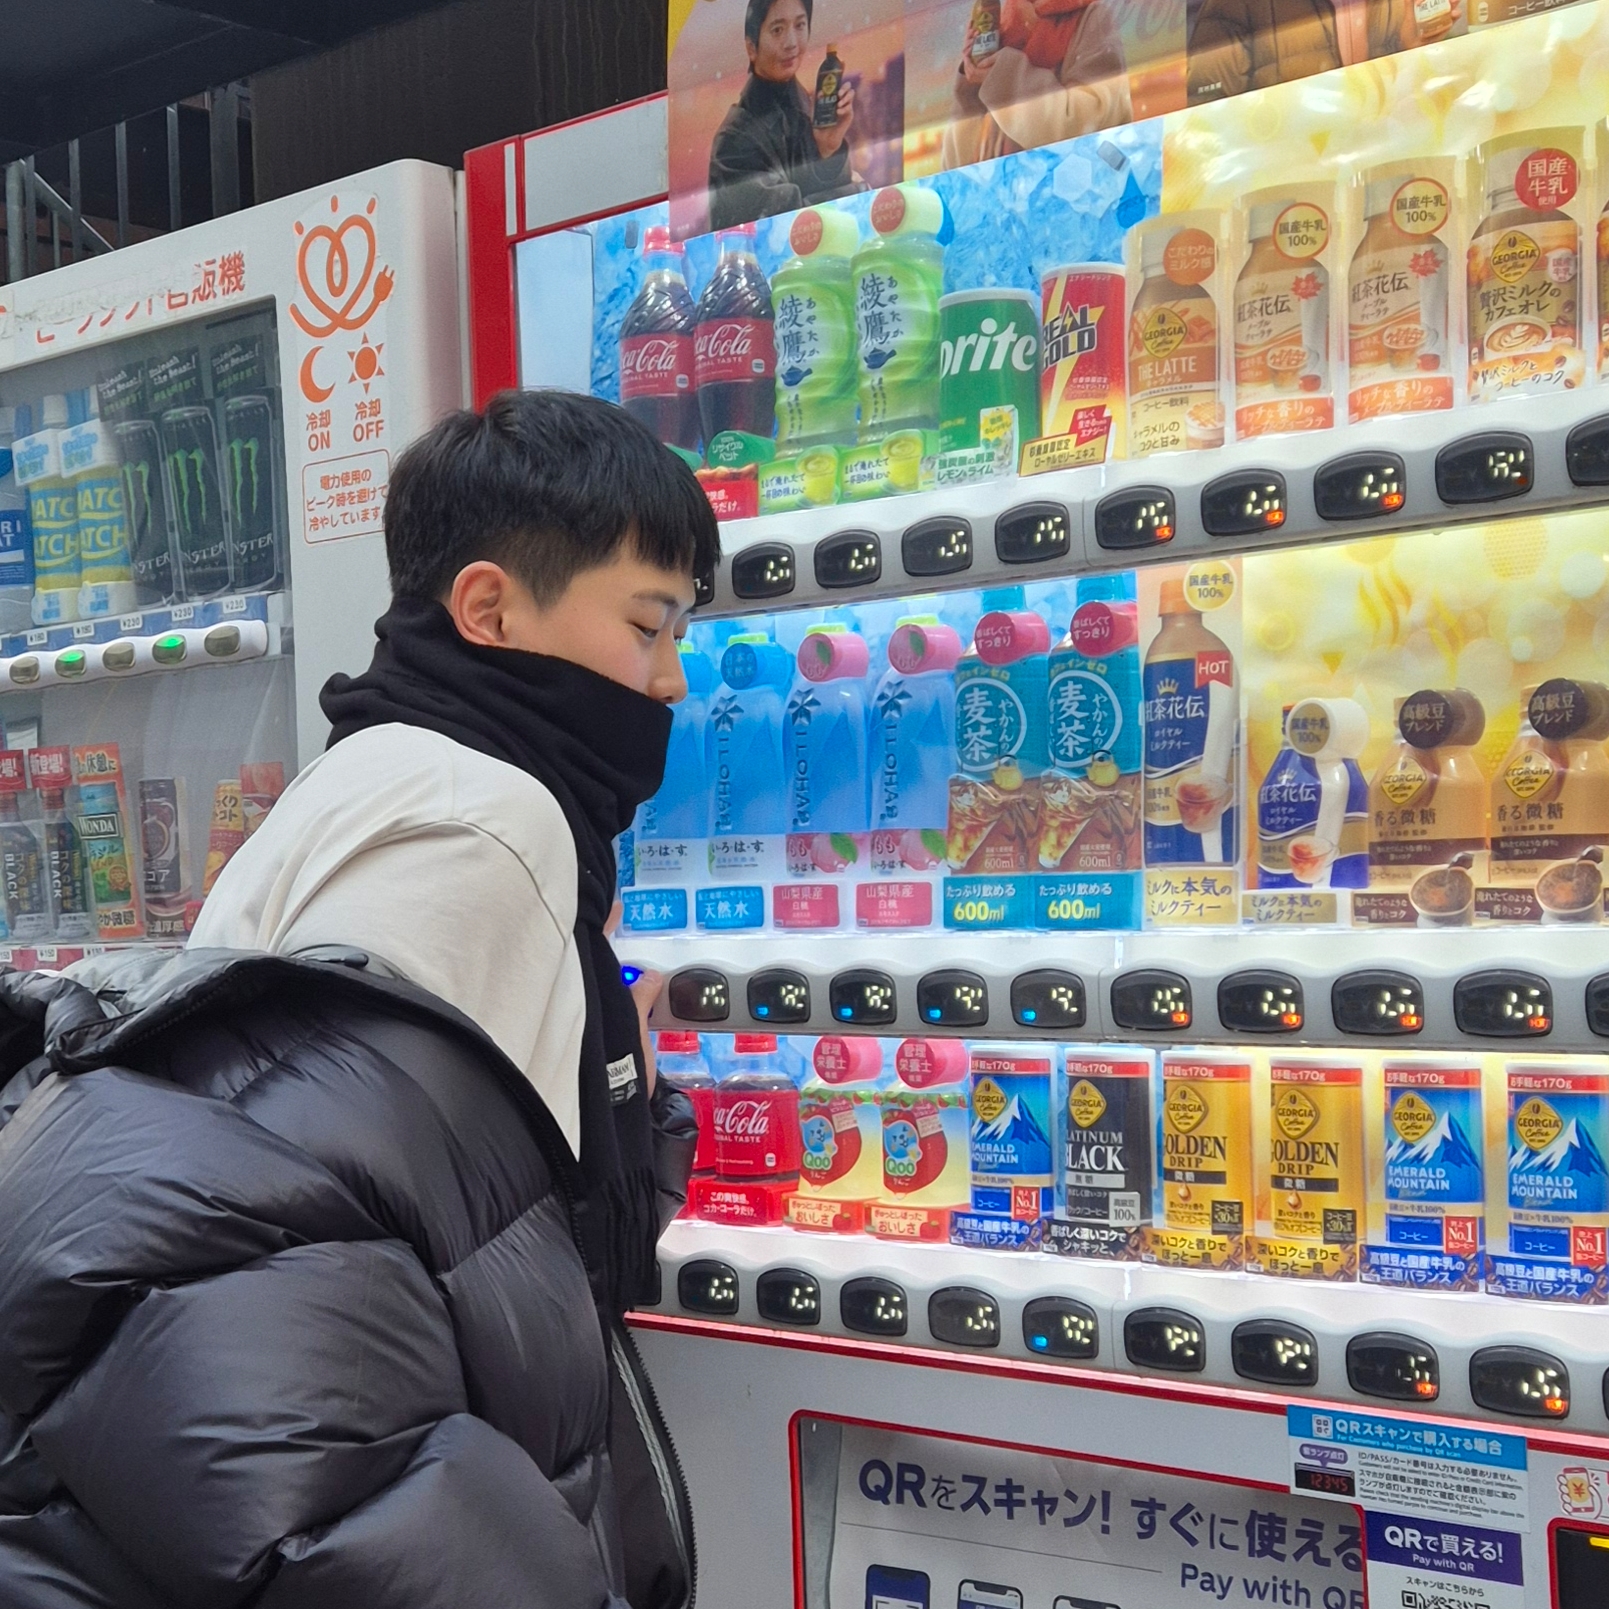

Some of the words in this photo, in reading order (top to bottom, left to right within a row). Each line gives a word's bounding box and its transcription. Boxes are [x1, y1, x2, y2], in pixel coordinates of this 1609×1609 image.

[1527, 157, 1568, 177] 国産
[1528, 177, 1568, 197] 牛乳
[1396, 195, 1447, 211] 国産牛乳
[1405, 209, 1436, 224] 100%
[1278, 220, 1327, 235] 国産牛乳
[1287, 233, 1317, 247] 100%
[1492, 249, 1537, 266] GEORGIA
[1351, 272, 1408, 303] 紅茶花伝
[1480, 281, 1562, 310] 贅沢ミルクの
[858, 272, 891, 349] 綾鷹
[1237, 294, 1291, 324] 紅茶花伝
[1485, 300, 1551, 323] カフェオレ
[778, 294, 807, 366] 綾鷹
[1144, 326, 1185, 341] GEORGIA
[1155, 355, 1197, 376] LATTE
[355, 398, 381, 421] 冷却
[306, 409, 331, 432] 冷却
[353, 419, 385, 442] OFF
[308, 430, 331, 452] ON
[320, 468, 372, 491] 電力使用の
[1188, 574, 1233, 587] 国産牛乳
[1197, 586, 1224, 599] 100%
[173, 607, 192, 619] ¥230
[225, 599, 244, 610] ¥230
[122, 617, 141, 628] ¥230
[1073, 626, 1110, 640] すっきり
[976, 635, 1012, 649] すっきり
[1198, 660, 1229, 675] HOT
[962, 687, 998, 762] 麦茶
[998, 698, 1014, 750] やかんの
[1056, 681, 1091, 758] 麦茶
[1092, 693, 1109, 745] やかんの
[1374, 808, 1436, 828] 香る微糖
[1497, 803, 1564, 822] 香る微糖
[984, 856, 1014, 869] 600ml
[1079, 854, 1112, 868] 600ml
[4, 853, 19, 900] BLACK
[50, 850, 62, 899] BLACK
[781, 887, 824, 899] 山梨県産
[866, 884, 914, 898] 山梨県産
[946, 883, 1016, 898] たっぷり飲める
[1039, 882, 1112, 897] たっぷり飲める
[1146, 876, 1232, 897] ミルクに本気の
[704, 900, 749, 919] 天然水
[792, 901, 809, 911] 白桃
[879, 899, 898, 909] 白桃
[1048, 898, 1101, 920] 600ml
[1151, 900, 1222, 917] ミルクティー
[1251, 894, 1322, 908] ミルクに本気の
[630, 902, 674, 922] 天然水
[953, 900, 1004, 921] 600ml
[1256, 908, 1315, 922] ミルクティー
[821, 1042, 841, 1056] 管理
[903, 1043, 926, 1058] 管理
[975, 1094, 1006, 1105] GEORGIA
[1071, 1098, 1102, 1108] GEORGIA
[1169, 1103, 1204, 1113] GEORGIA
[1278, 1108, 1315, 1118] GEORGIA
[1393, 1111, 1434, 1123] GEORGIA
[1517, 1117, 1560, 1129] GEORGIA
[734, 1135, 761, 1143] TASTE
[803, 1153, 831, 1169] Qoo
[886, 1158, 915, 1175] Qoo
[1169, 1156, 1204, 1169] DRIP
[1278, 1163, 1315, 1176] DRIP
[1388, 1165, 1446, 1179] EMERALD
[1512, 1173, 1574, 1187] EMERALD
[1387, 1178, 1450, 1191] MOUNTAIN
[1512, 1186, 1578, 1200] MOUNTAIN
[977, 1198, 1001, 1208] コーヒー
[1016, 1191, 1037, 1211] No.1
[795, 1212, 830, 1225] おいしさ
[1113, 1208, 1136, 1222] 100%
[878, 1221, 916, 1235] おいしさ
[1399, 1231, 1429, 1241] コーヒー
[1449, 1222, 1474, 1244] No.1
[1151, 1233, 1227, 1252] 深いコクと香りで
[1525, 1241, 1556, 1252] コーヒー
[1576, 1231, 1603, 1255] No.1
[1257, 1242, 1340, 1262] 深いコクと香りで
[1370, 1251, 1465, 1272] 高級豆と国産牛乳の
[1380, 1267, 1451, 1285] 王道バランス
[1495, 1263, 1594, 1284] 高級豆と国産牛乳の
[1506, 1280, 1579, 1297] 王道バランス
[1335, 1418, 1503, 1457] QRスキャンで購入する場合
[1310, 1473, 1348, 1492] 12345
[858, 1458, 1112, 1535] QRをスキャン!
[1130, 1496, 1364, 1574] すぐに使える
[1384, 1525, 1504, 1564] QRで買える!
[1412, 1553, 1431, 1567] Pay
[1433, 1558, 1457, 1570] with
[1459, 1561, 1475, 1573] QR
[1180, 1562, 1234, 1601] Pay
[1244, 1577, 1311, 1608] with
[1406, 1576, 1485, 1597] スキャンはこちらから
